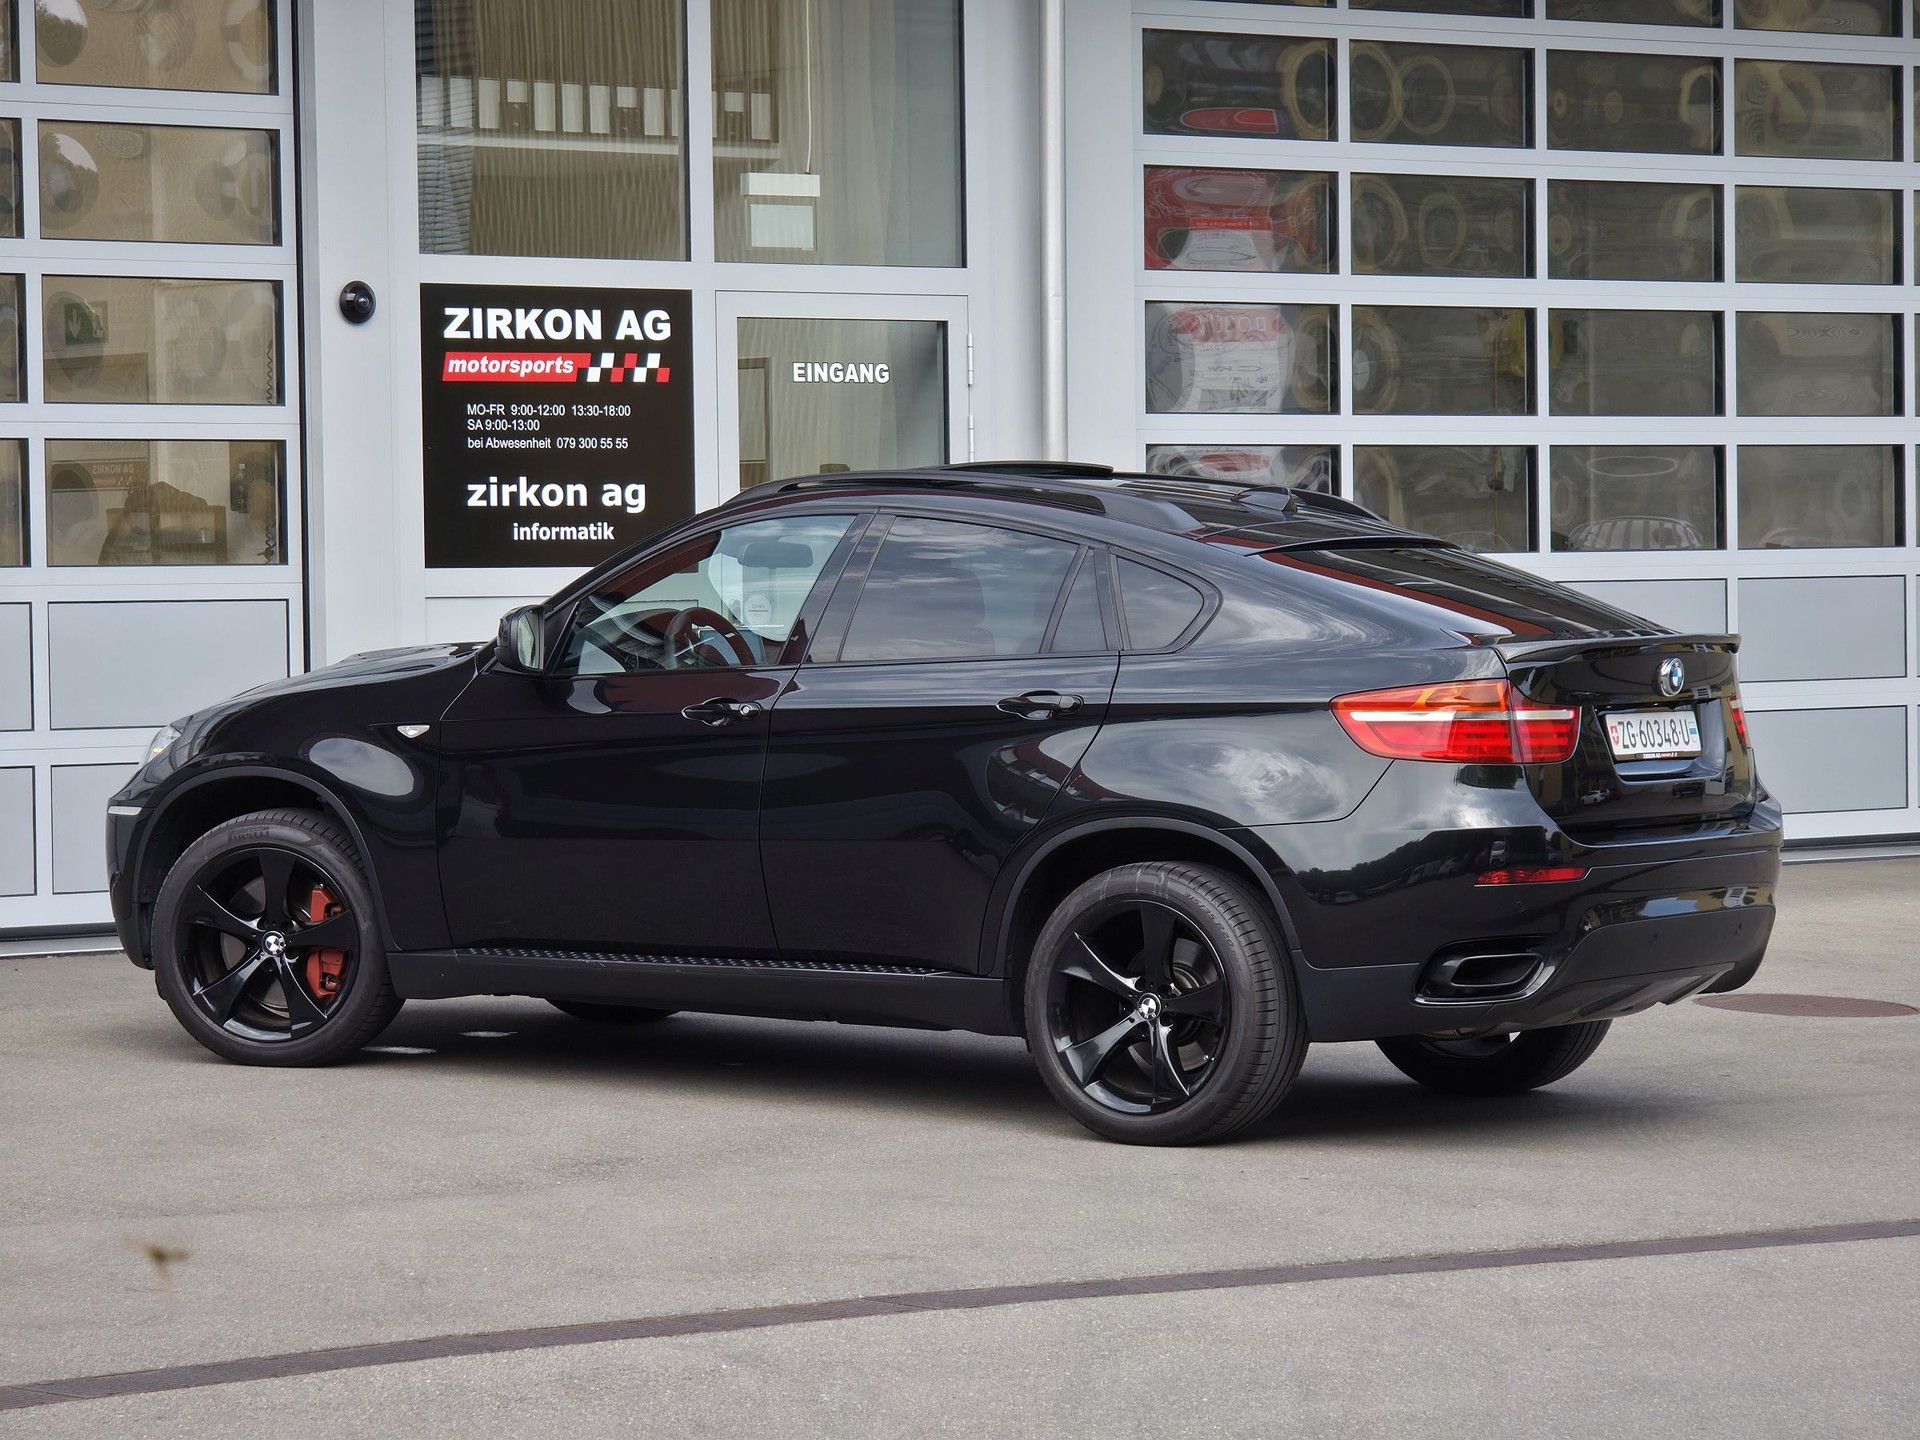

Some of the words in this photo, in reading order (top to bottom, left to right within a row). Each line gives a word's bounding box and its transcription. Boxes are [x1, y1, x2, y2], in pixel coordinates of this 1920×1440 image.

[443, 307, 602, 341] ZIRKON
[614, 309, 672, 342] AG
[447, 355, 574, 378] motorsports
[793, 362, 890, 383] EINGANG
[467, 403, 506, 416] MO-FR
[510, 404, 566, 416] 9:00-12:00
[571, 404, 631, 417] 13:30-18:00
[467, 418, 484, 431] SA
[485, 418, 541, 431] 9:00-13:00
[467, 436, 484, 449] bei
[485, 436, 552, 449] Abwesenheit
[556, 437, 576, 449] 079
[578, 437, 598, 449] 300
[600, 437, 613, 449] 55
[615, 437, 629, 449] 55
[467, 476, 588, 508] zirkon
[601, 483, 646, 514] ag
[513, 521, 615, 541] informatik
